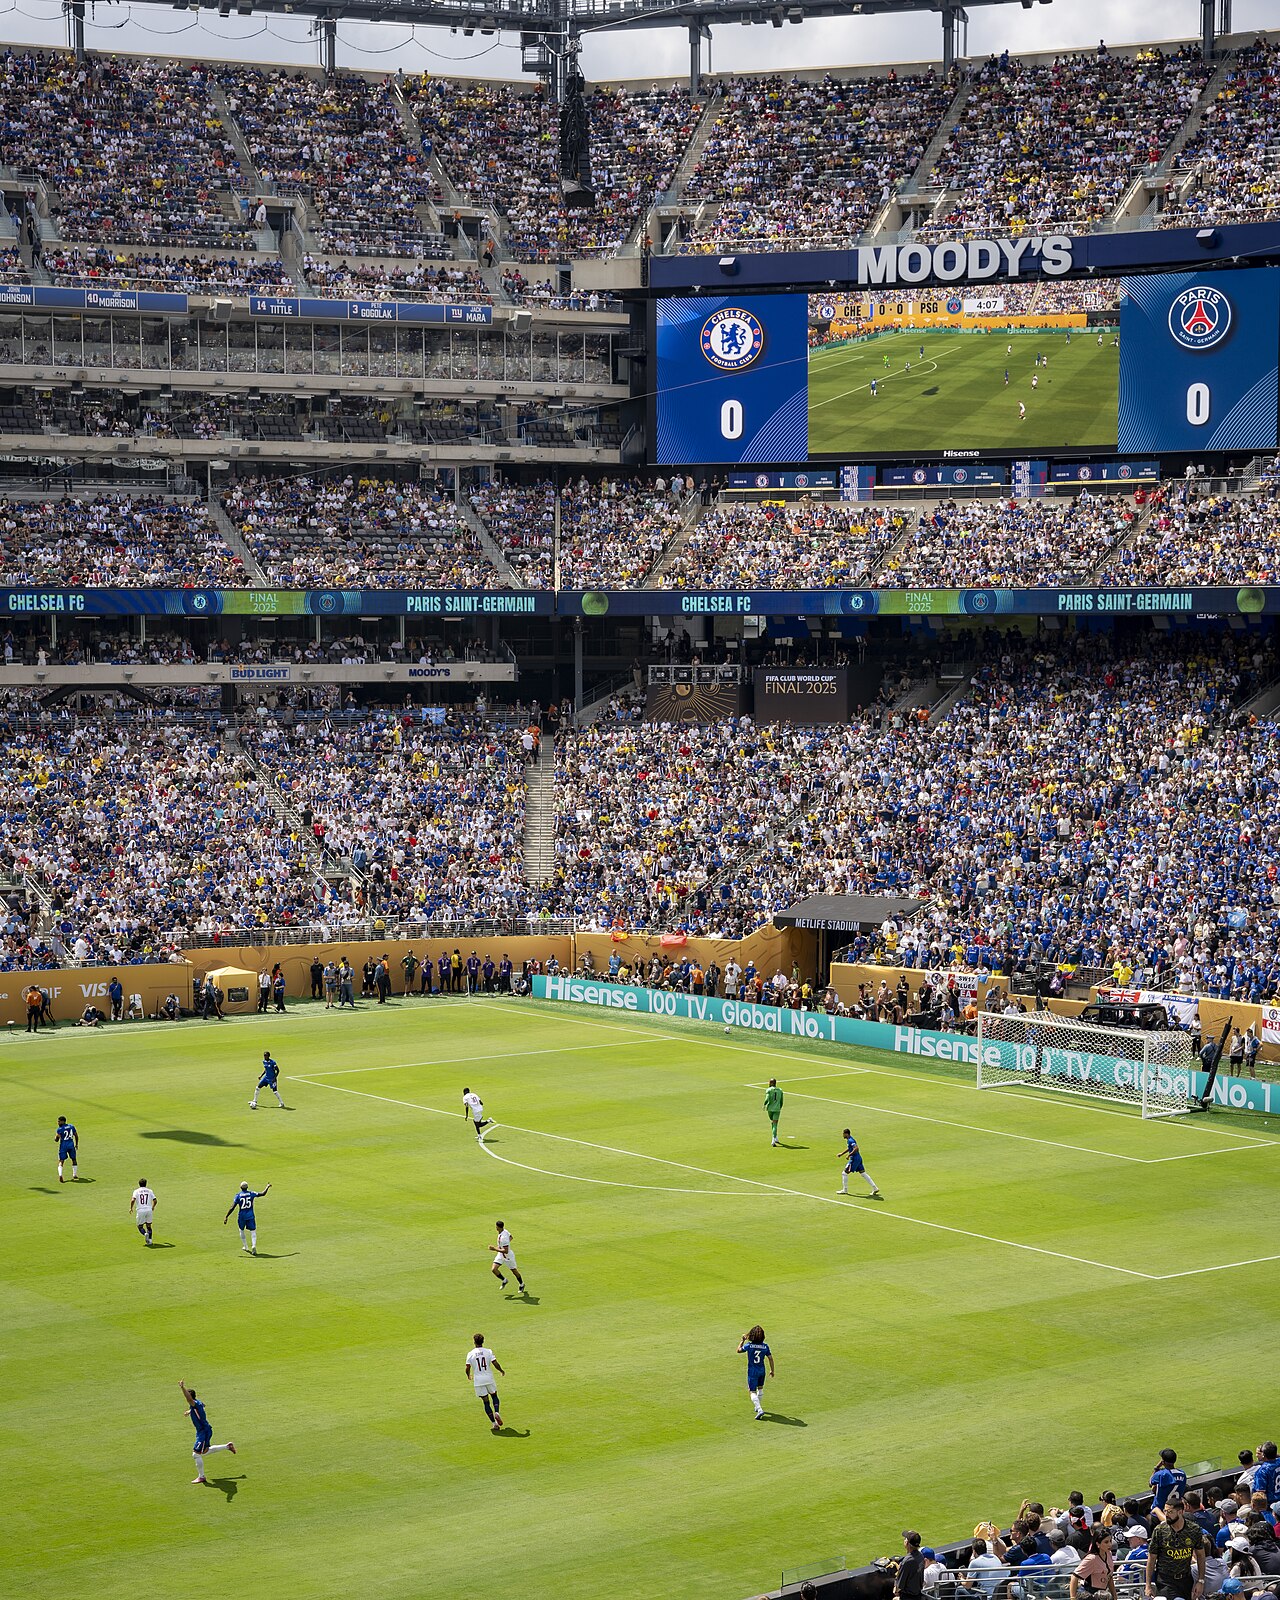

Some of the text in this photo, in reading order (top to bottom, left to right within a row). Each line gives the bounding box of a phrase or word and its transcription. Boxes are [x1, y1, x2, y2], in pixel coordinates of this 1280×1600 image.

[857, 235, 1073, 284] MOODY'S
[87, 293, 99, 304] 40
[99, 297, 136, 309] MORRISON
[1179, 289, 1221, 306] PARIS
[256, 301, 267, 311] 14
[269, 305, 293, 315] TITTLE
[352, 304, 358, 314] 3
[844, 300, 938, 318] CHE 0 0 PSG
[976, 300, 998, 311] 4:07
[361, 308, 392, 319] GOGOLAK
[466, 312, 486, 323] MARA
[711, 310, 752, 325] CHELSEA
[710, 354, 753, 367] FOOTBALL CLUB
[1186, 382, 1210, 425] 0
[721, 399, 743, 440] 0
[943, 450, 980, 458] Hisense
[8, 594, 85, 611] CHELSEA FC
[249, 593, 279, 602] FINAL
[905, 592, 933, 602] FINAL
[1058, 593, 1192, 610] PARIS SAINT-GERMAIN
[253, 603, 277, 612] 2025
[406, 596, 536, 612] PARIS SAINT-GERMAIN
[682, 596, 751, 612] CHELSEA FC
[908, 602, 931, 612] 2025
[232, 669, 288, 678] BUD LIGHT
[408, 668, 451, 677] MOODY'S
[765, 682, 837, 694] FINAL 2025
[795, 918, 860, 932] METLIFE STADIUM
[958, 975, 976, 983] SW17
[78, 982, 110, 998] VIS
[545, 977, 836, 1041] Hisense 100" TV, Global No. 1
[895, 1028, 1000, 1067] Hisense
[1114, 1060, 1196, 1098] Global
[1211, 1079, 1255, 1110] No.
[1262, 1083, 1271, 1112] 1
[63, 1129, 73, 1141] 24
[239, 1197, 252, 1210] 25
[753, 1350, 761, 1363] 3
[476, 1357, 487, 1371] 14
[1167, 1548, 1192, 1557] QATAR
